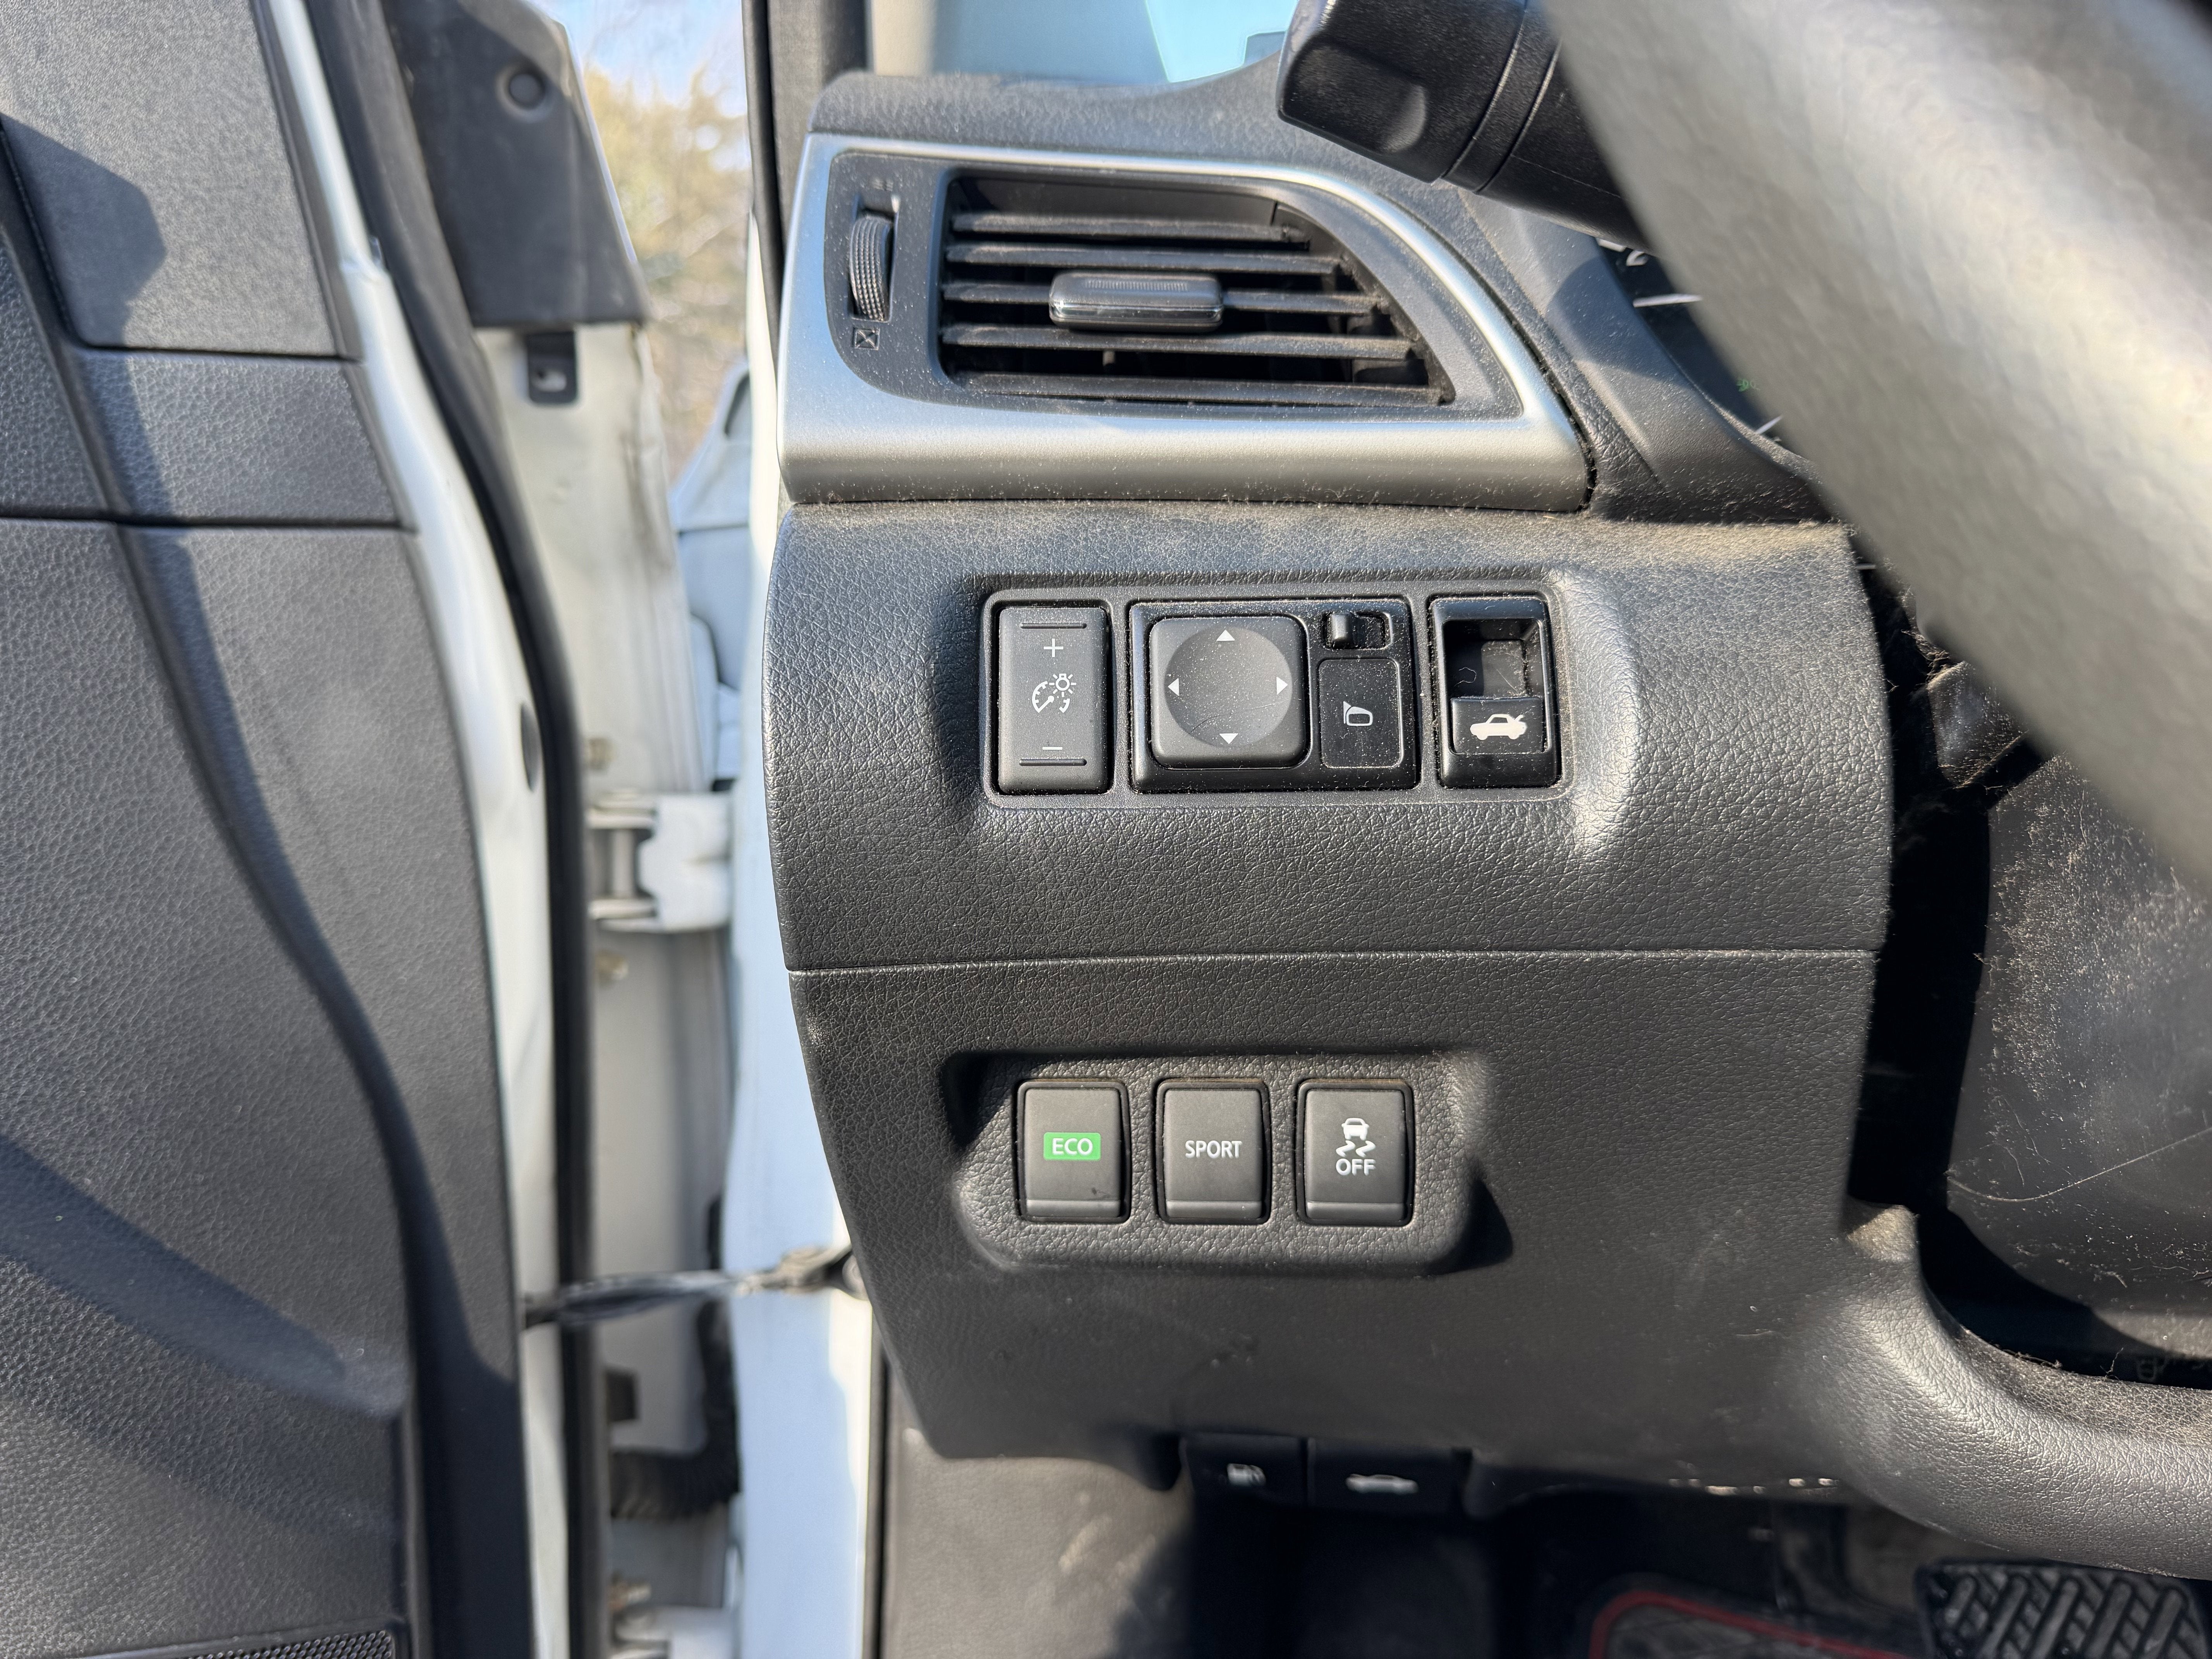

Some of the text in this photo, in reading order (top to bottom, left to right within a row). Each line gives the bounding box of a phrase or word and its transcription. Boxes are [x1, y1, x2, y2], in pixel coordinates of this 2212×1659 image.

[1052, 1137, 1093, 1156] ECO
[1185, 1140, 1242, 1159] SPORT
[1335, 1158, 1376, 1176] OFF
